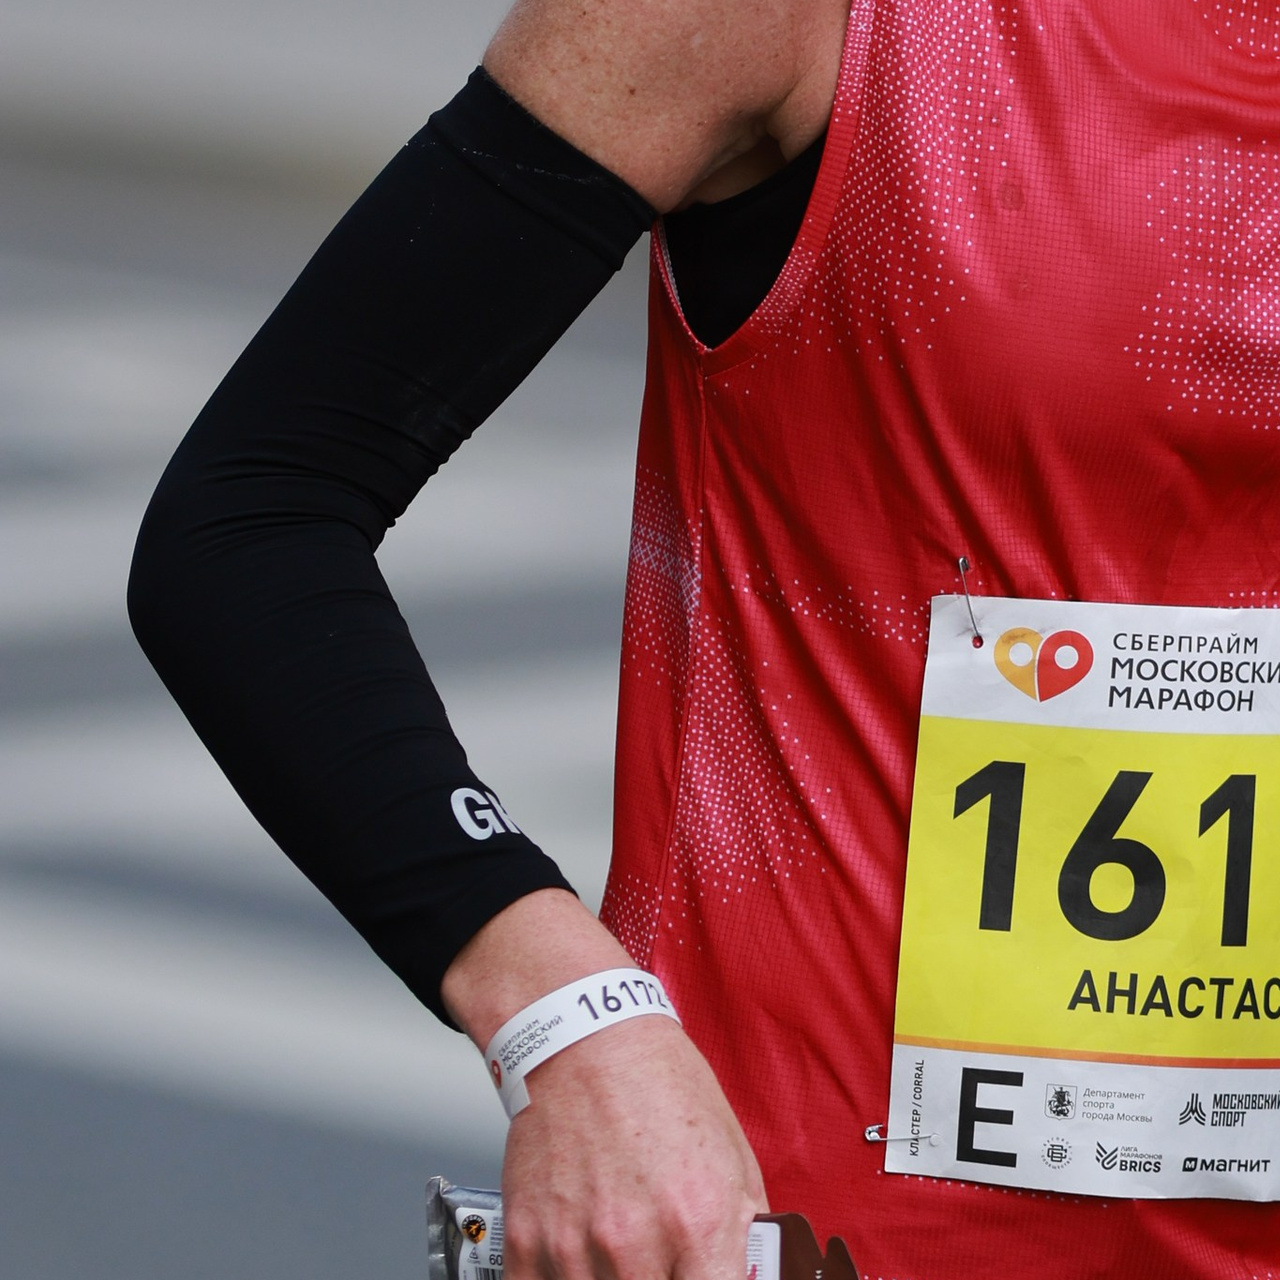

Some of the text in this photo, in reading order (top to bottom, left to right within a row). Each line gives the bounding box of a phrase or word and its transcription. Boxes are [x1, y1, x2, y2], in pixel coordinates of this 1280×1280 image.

[1113, 632, 1258, 655] СБЕРПРАЙМ
[1108, 685, 1254, 712] МАРАФОН
[450, 787, 521, 840] G
[577, 980, 668, 1021] 16172
[502, 1015, 564, 1066] МОСКОВСКИЙ
[506, 1036, 550, 1075] МАРАФОН
[914, 1059, 925, 1100] CORRAL
[1082, 1101, 1115, 1111] спорта
[1083, 1088, 1145, 1100] Департамент
[1082, 1112, 1153, 1123] города Москвы
[1211, 1111, 1246, 1127] СПОРТ
[909, 1109, 923, 1157] КЛАСТЕР
[1119, 1160, 1161, 1173] BRICS
[1120, 1152, 1163, 1160] МАРАФОНОВ
